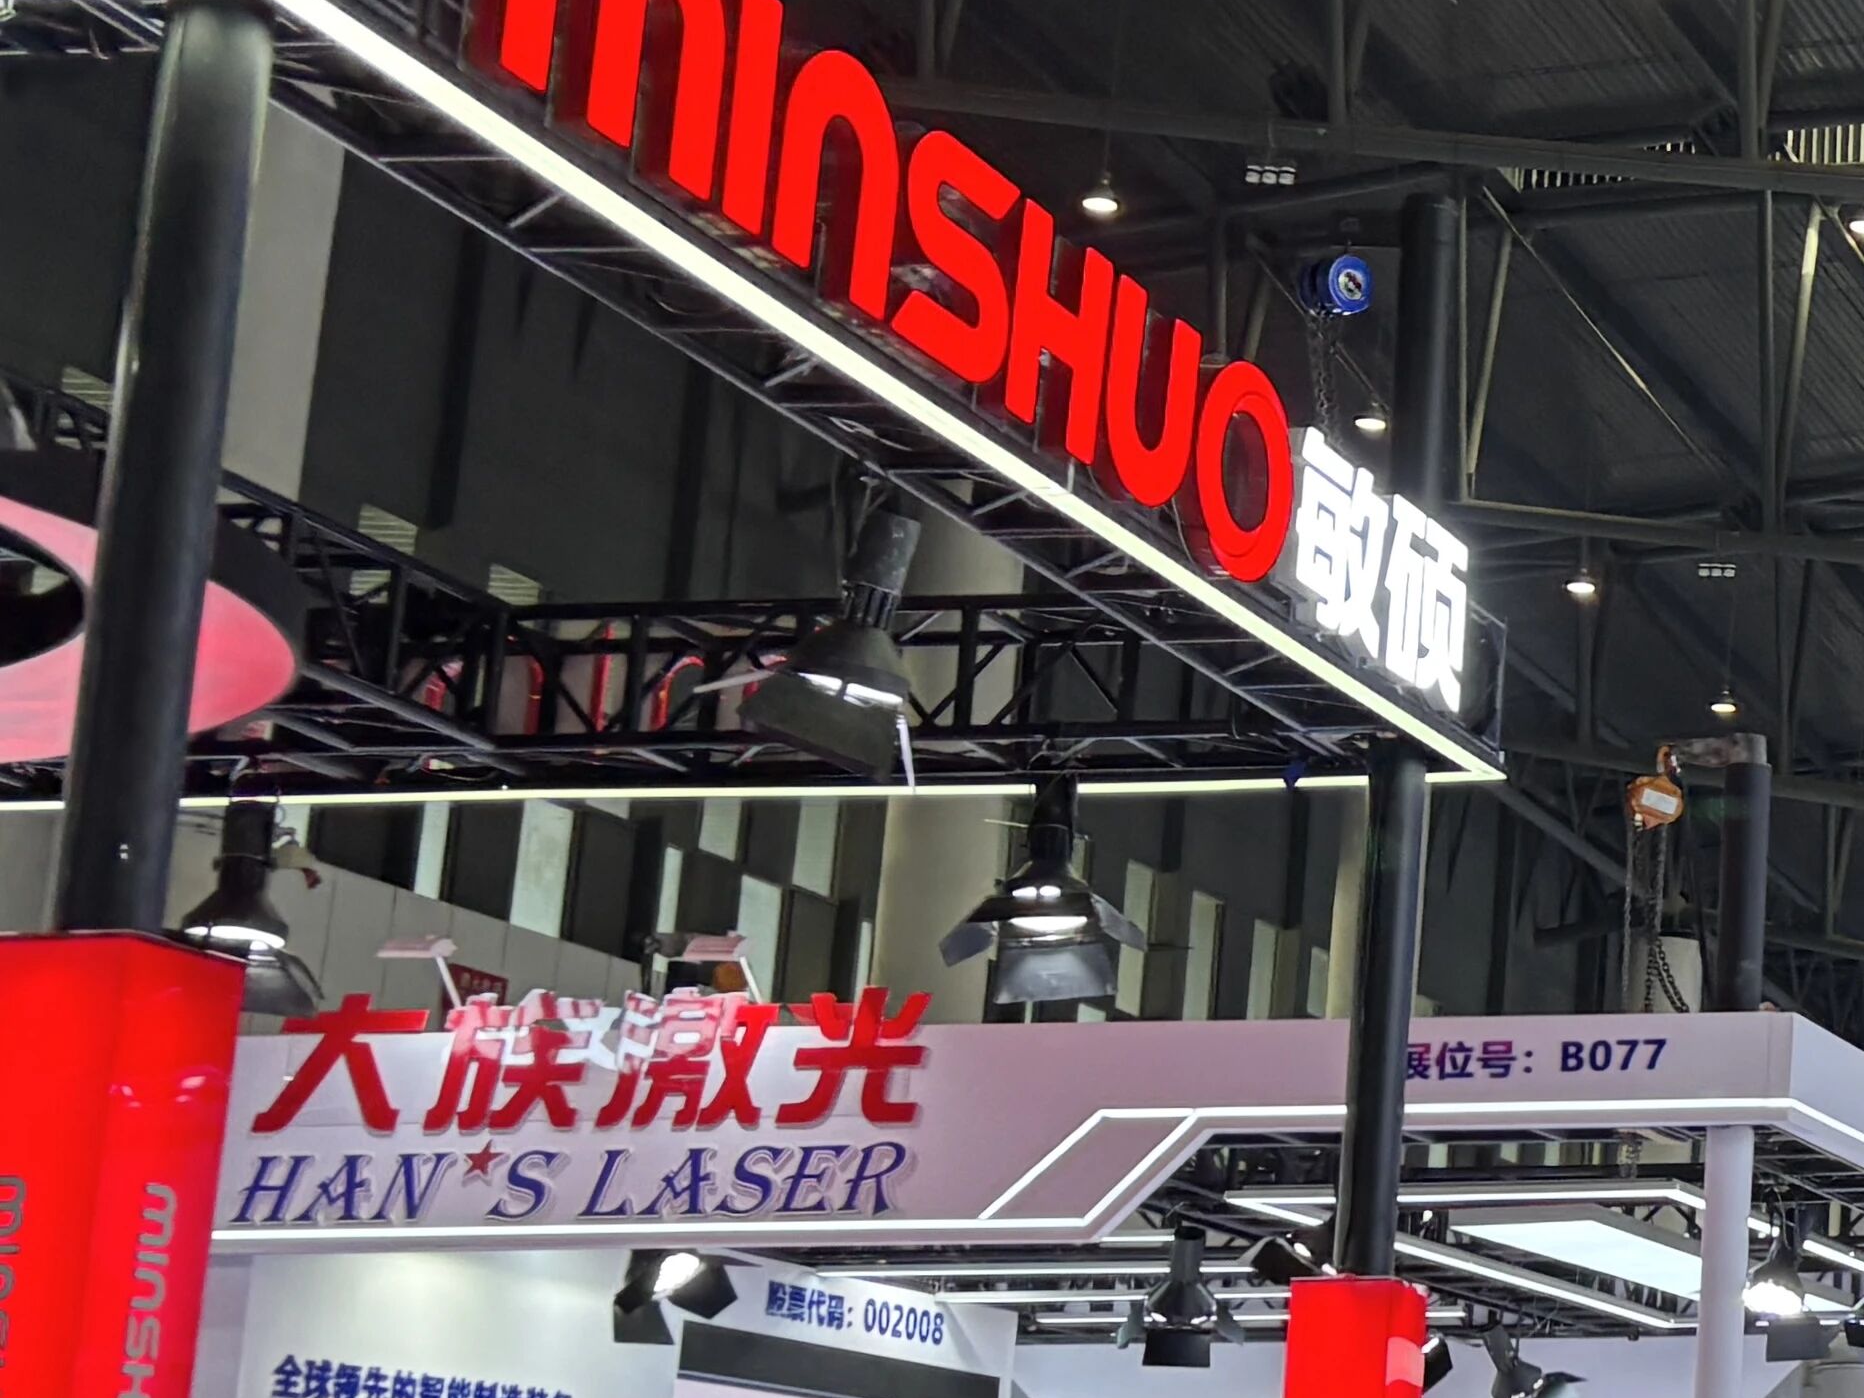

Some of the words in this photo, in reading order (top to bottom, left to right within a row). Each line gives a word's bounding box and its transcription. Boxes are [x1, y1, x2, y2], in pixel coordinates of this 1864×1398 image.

[1294, 427, 1470, 716] 敏硕
[251, 987, 932, 1135] 大族激光
[581, 1140, 914, 1222] LASER
